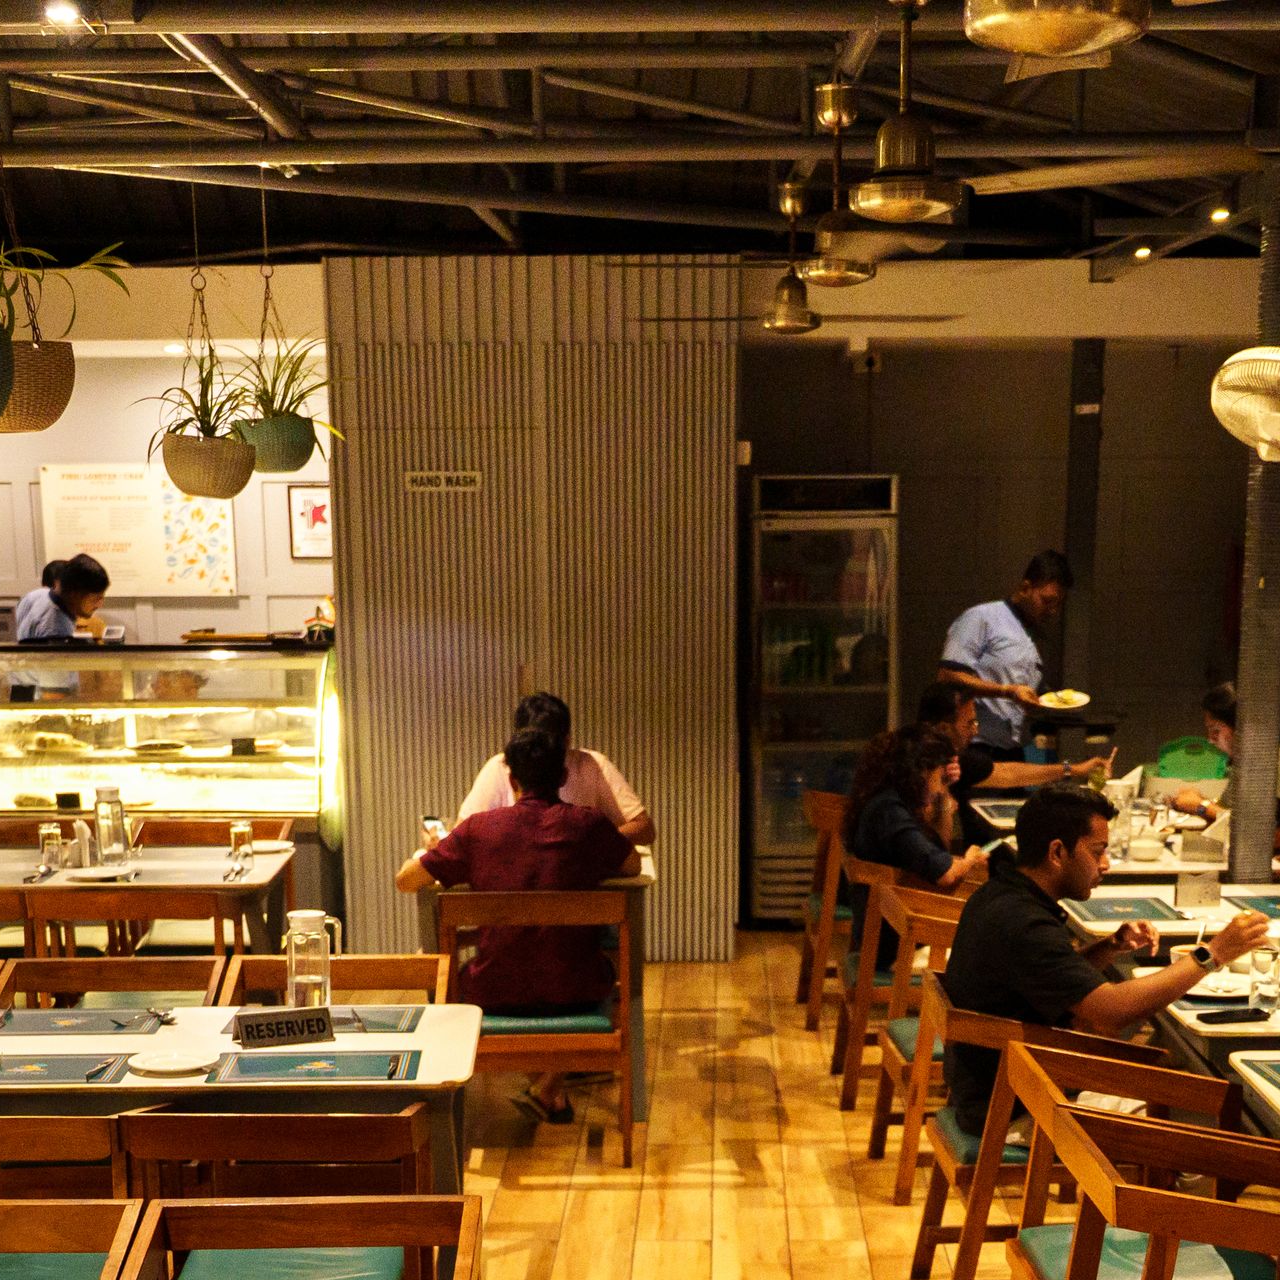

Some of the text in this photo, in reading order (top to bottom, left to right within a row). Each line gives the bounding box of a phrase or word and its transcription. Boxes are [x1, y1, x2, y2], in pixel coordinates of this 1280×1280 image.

[410, 475, 477, 487] HAND WASH
[244, 1017, 327, 1041] RESERVED
